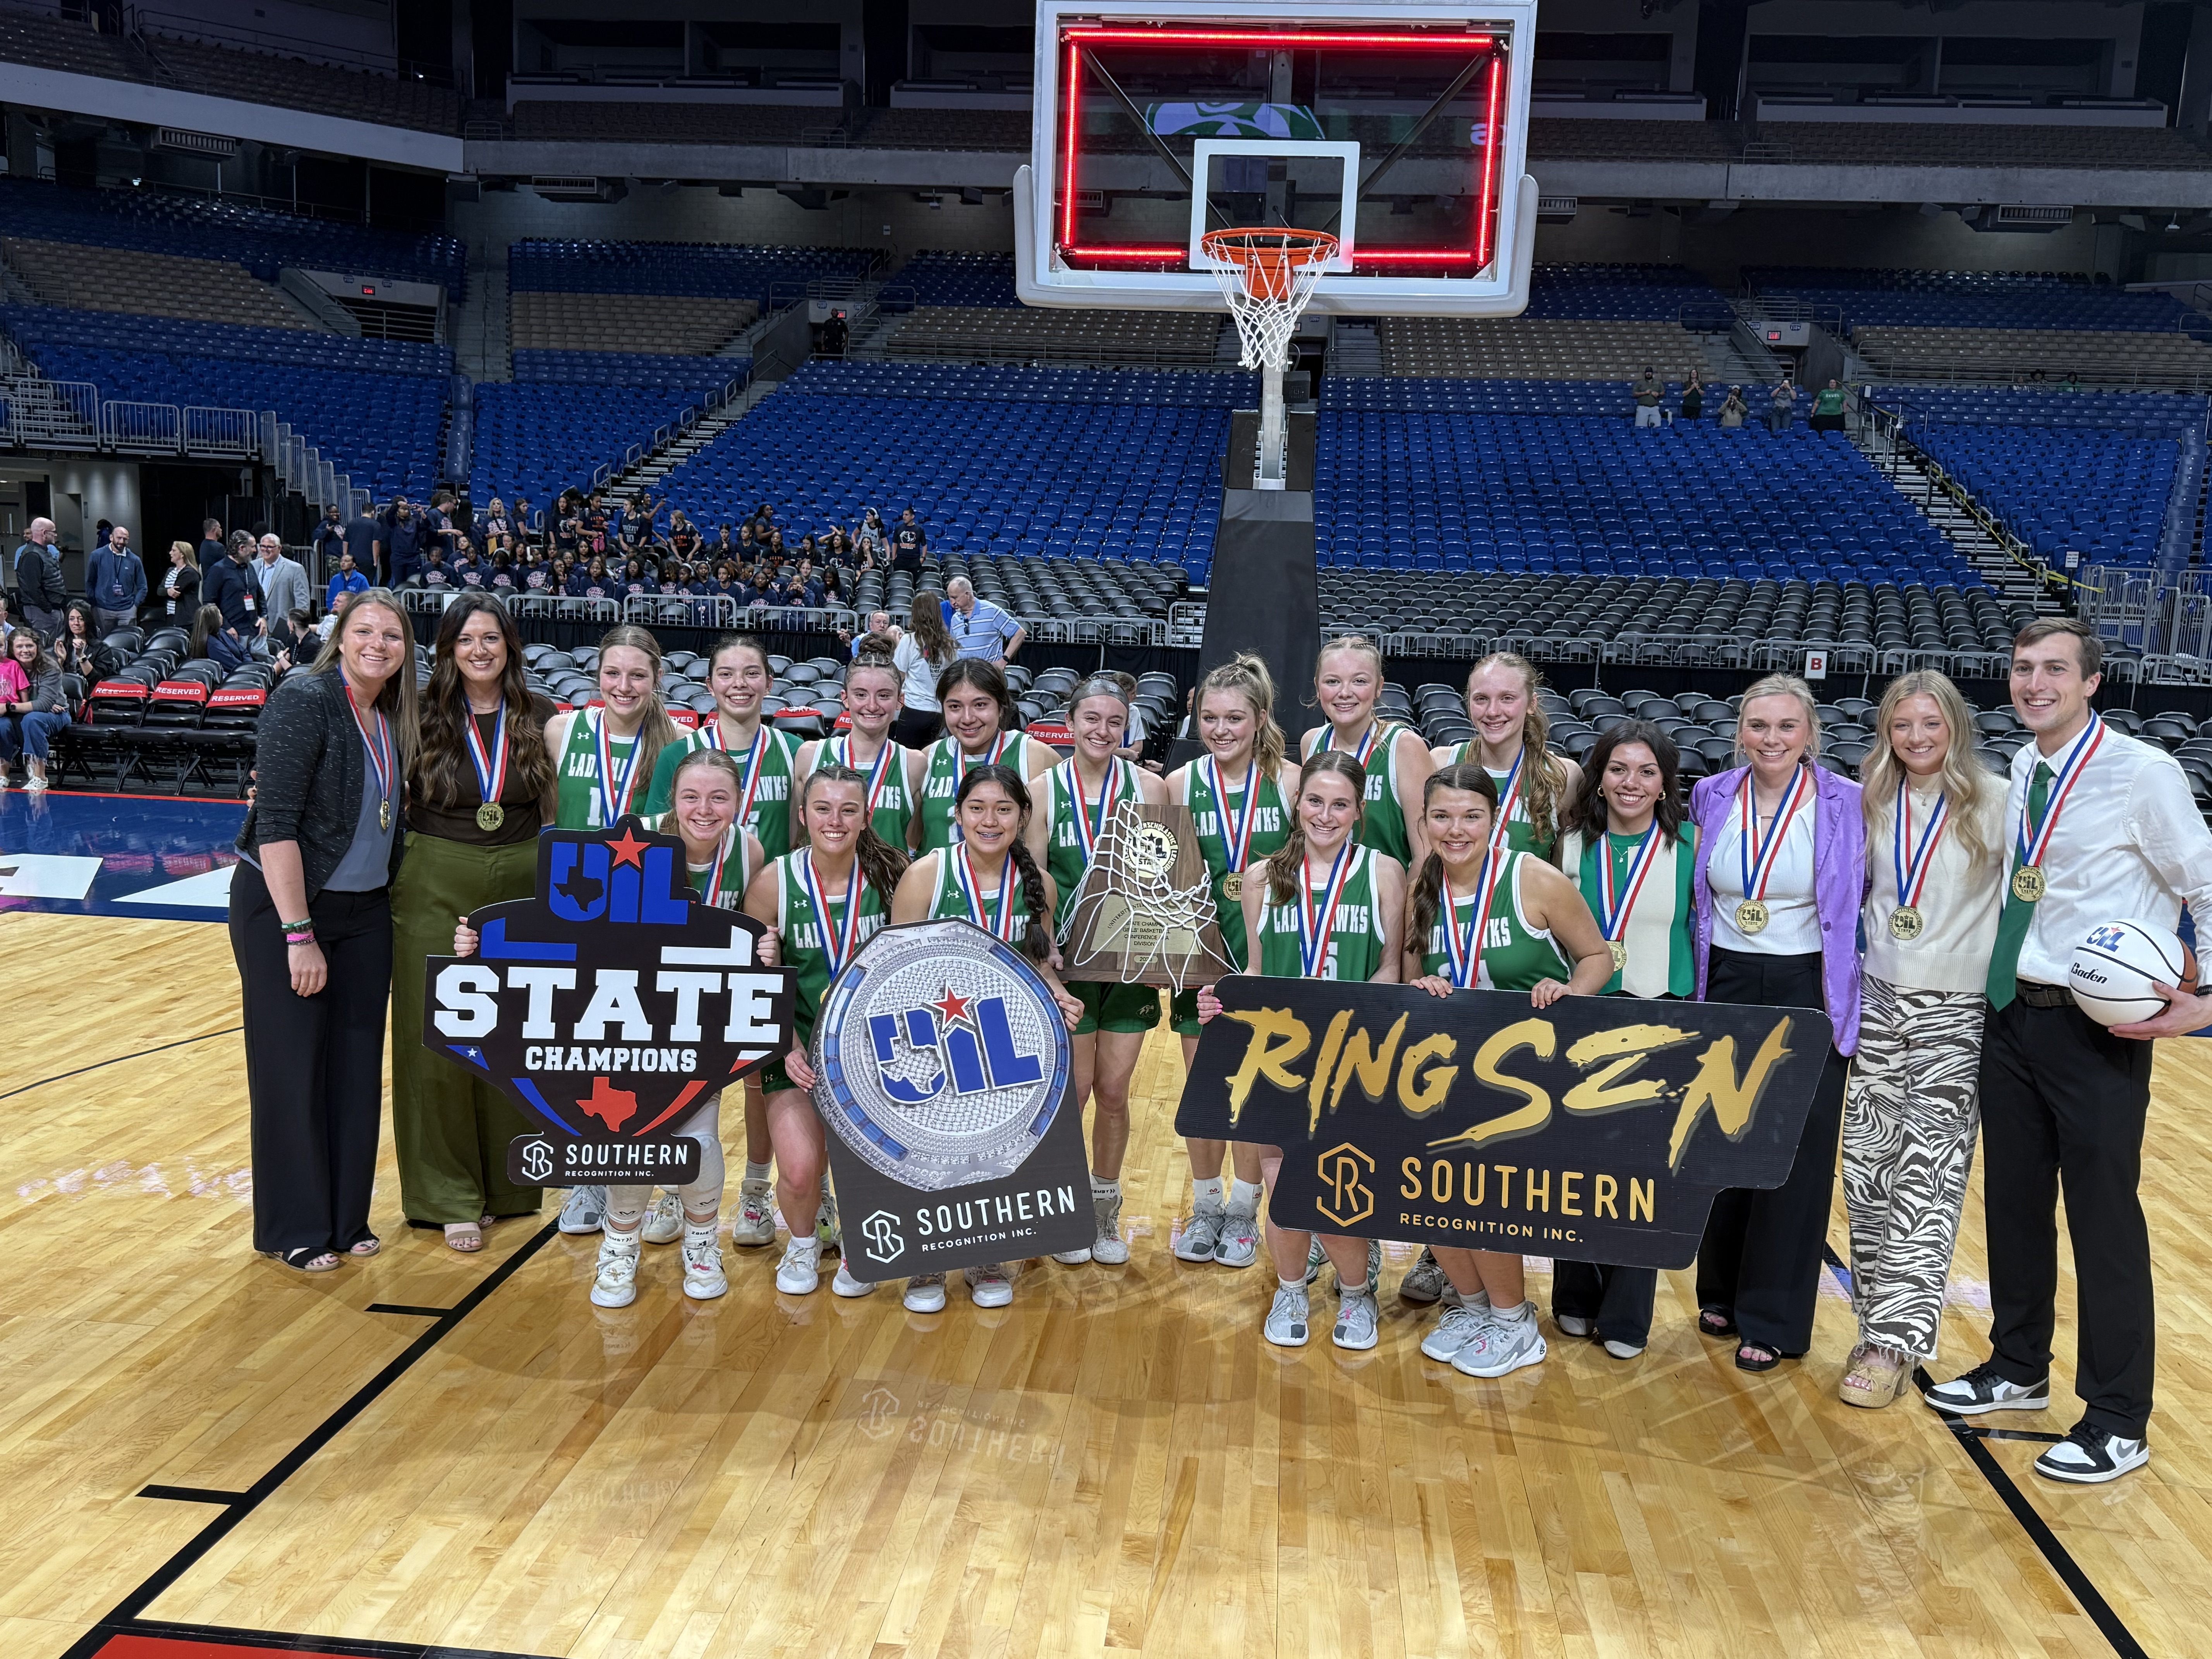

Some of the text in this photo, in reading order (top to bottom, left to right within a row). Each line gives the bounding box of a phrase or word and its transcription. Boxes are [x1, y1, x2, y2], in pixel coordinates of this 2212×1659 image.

[1810, 658, 1822, 670] B
[156, 687, 201, 695] RESERVED
[1028, 730, 1075, 738] RESERVED
[568, 752, 599, 779] LAD
[754, 776, 788, 802] AWKS
[929, 776, 954, 799] LAD
[1193, 811, 1217, 836] LAD
[1273, 905, 1298, 933] LAD
[2070, 962, 2108, 984] Baden
[434, 965, 784, 1043] STATE
[526, 1046, 697, 1072] CHAMPIONS
[566, 1144, 687, 1165] SOUTHERN
[1401, 1156, 1655, 1223] SOUTHERN
[916, 1185, 1075, 1236] SOUTHERN
[922, 1228, 1037, 1252] RECOGNITION INC.
[1400, 1213, 1584, 1243] RECOGNITION INC.
